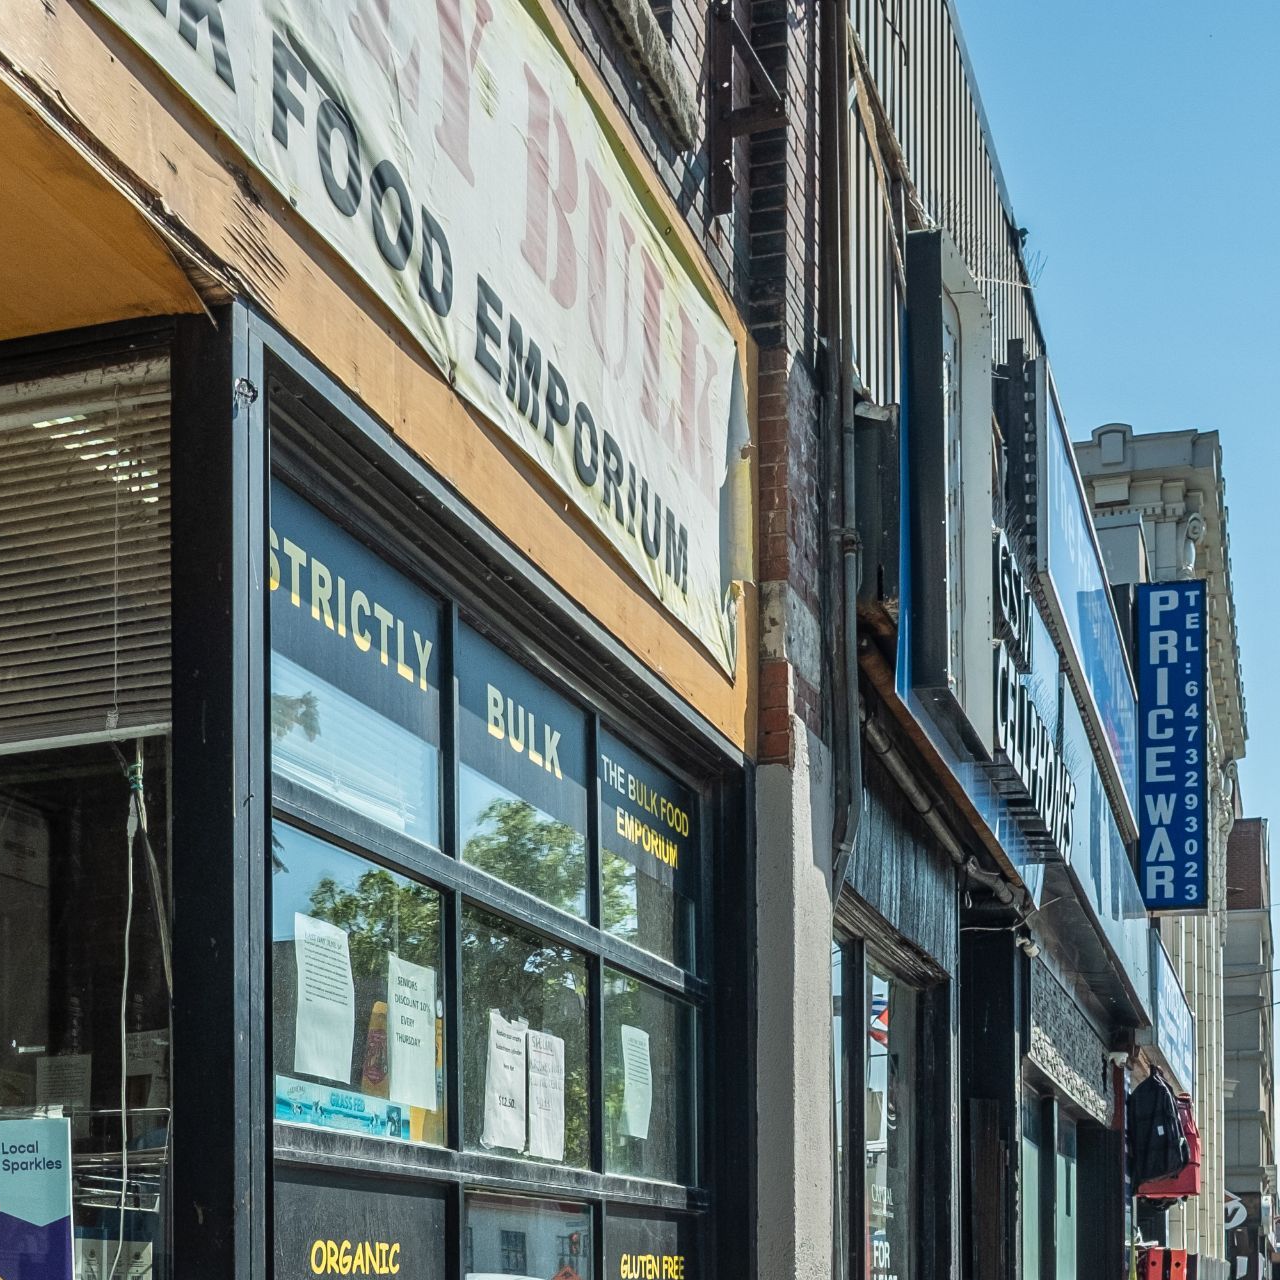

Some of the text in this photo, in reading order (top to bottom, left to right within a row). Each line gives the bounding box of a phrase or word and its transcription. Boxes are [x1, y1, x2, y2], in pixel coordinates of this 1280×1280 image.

[521, 61, 720, 507] BULK
[271, 28, 690, 595] FOOD EMPORIUM
[487, 683, 563, 780] BULK
[1145, 590, 1179, 899] PRICE WAR
[601, 753, 690, 838] THE BULK FOOD
[616, 806, 679, 870] EMPORIUM
[397, 976, 418, 991] SENIORS
[394, 995, 420, 1010] DISCOUNT
[400, 1016, 415, 1028] EVERY
[396, 1032, 421, 1047] THURSDAY
[1, 1141, 39, 1156] Local
[1, 1155, 63, 1174] Sparkles
[310, 1240, 401, 1275] ORGANIC
[620, 1254, 685, 1280] GLUTEN FREE
[873, 1240, 891, 1268] FOR
